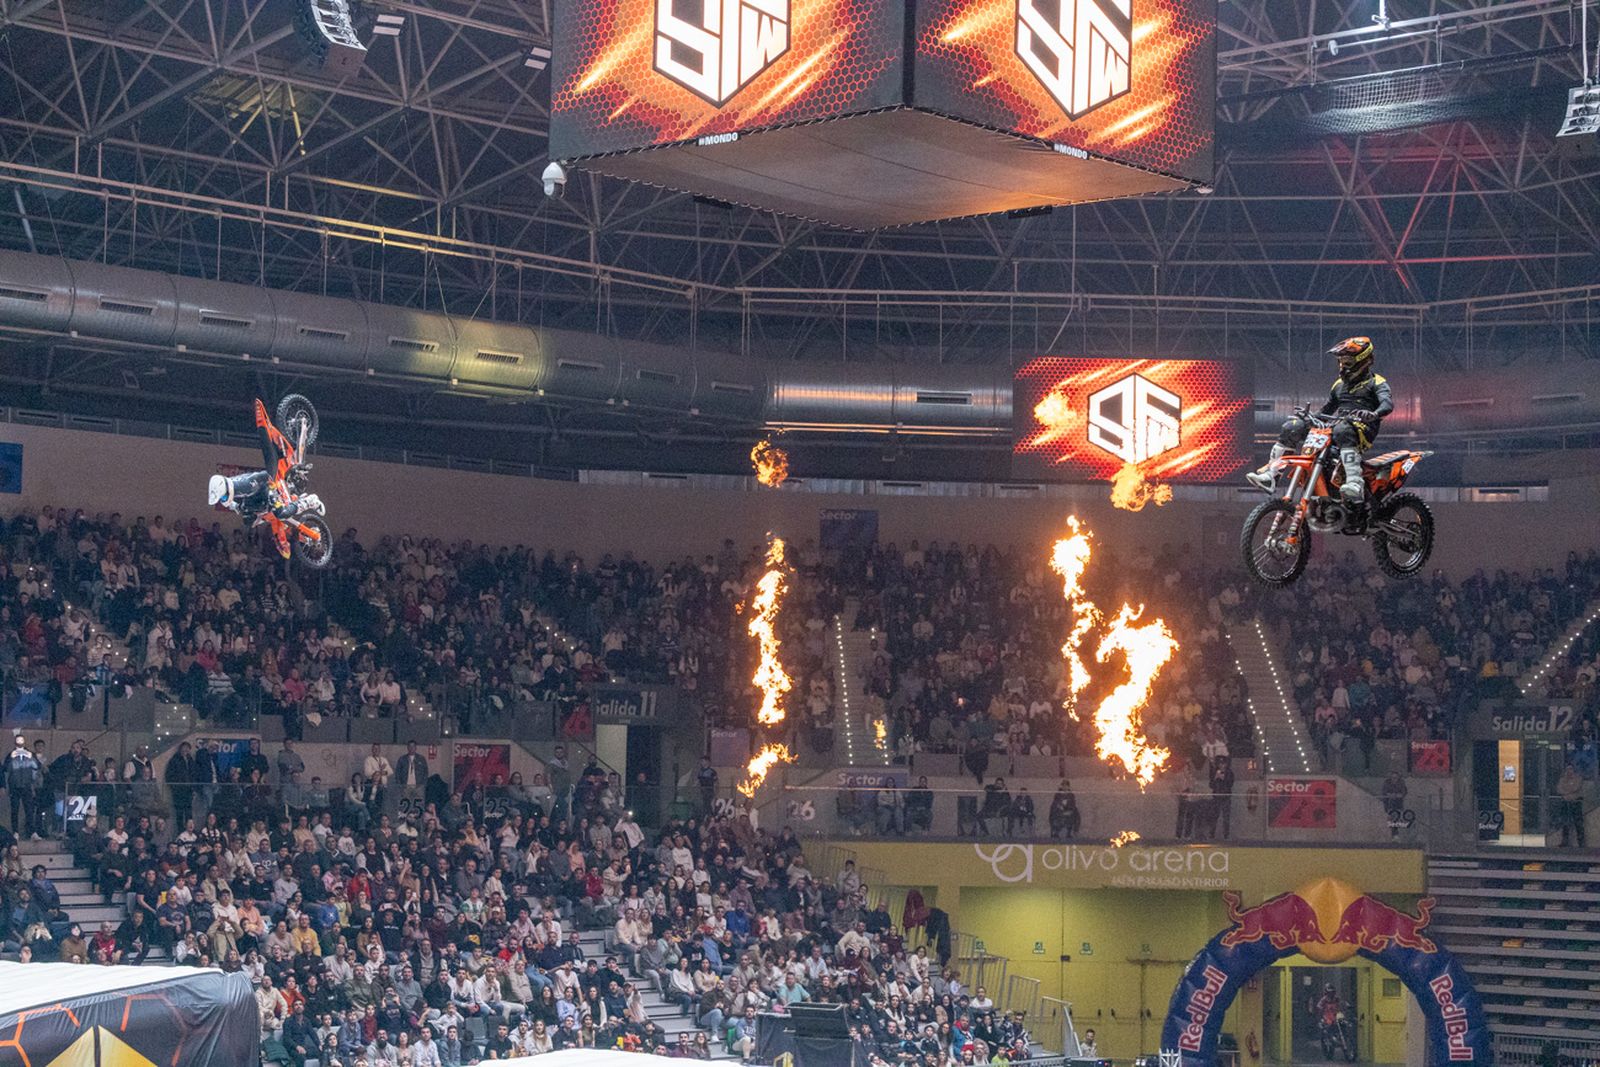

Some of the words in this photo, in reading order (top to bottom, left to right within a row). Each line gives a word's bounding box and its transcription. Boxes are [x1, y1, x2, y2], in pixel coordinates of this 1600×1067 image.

[641, 691, 658, 717] 11
[1491, 715, 1547, 732] Salida
[1548, 705, 1573, 731] 12
[196, 739, 238, 753] Stor
[454, 744, 491, 758] Sector
[1267, 780, 1312, 793] Sector
[68, 795, 98, 816] 24
[1042, 844, 1119, 871] olivo
[1129, 850, 1230, 873] arena
[1182, 877, 1229, 888] INTERIOR
